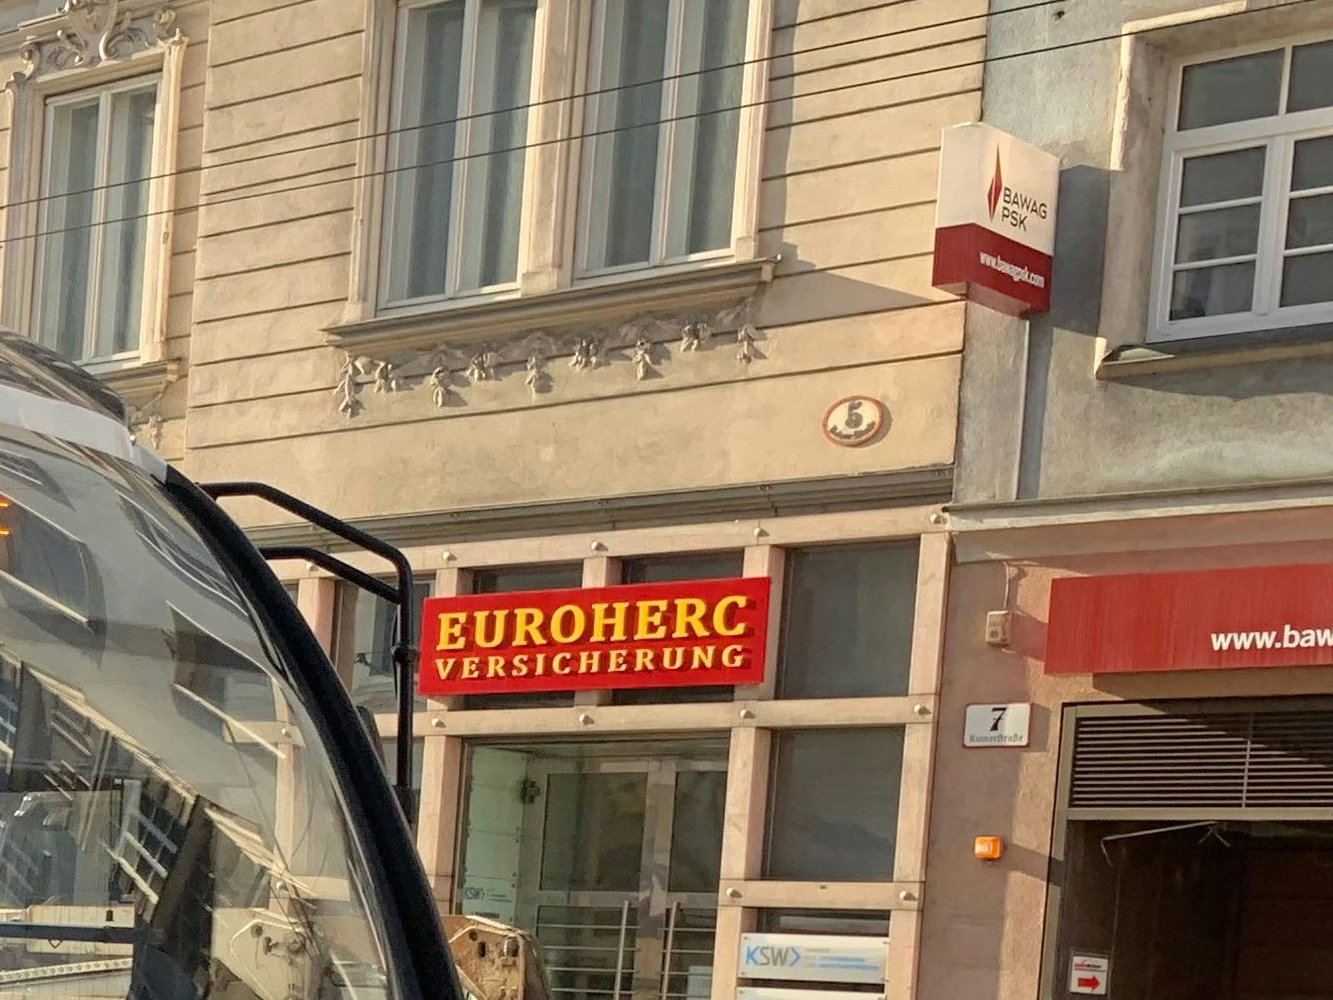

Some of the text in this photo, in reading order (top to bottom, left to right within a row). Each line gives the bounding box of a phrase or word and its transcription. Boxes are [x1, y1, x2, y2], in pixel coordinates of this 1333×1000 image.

[1003, 187, 1047, 219] BAWAG
[1001, 207, 1027, 231] PSK
[844, 401, 863, 429] 5
[436, 595, 748, 651] EUROHERC
[1210, 623, 1333, 651] www.baw
[435, 644, 745, 680] VERSICHERUNG
[989, 707, 1008, 731] 7
